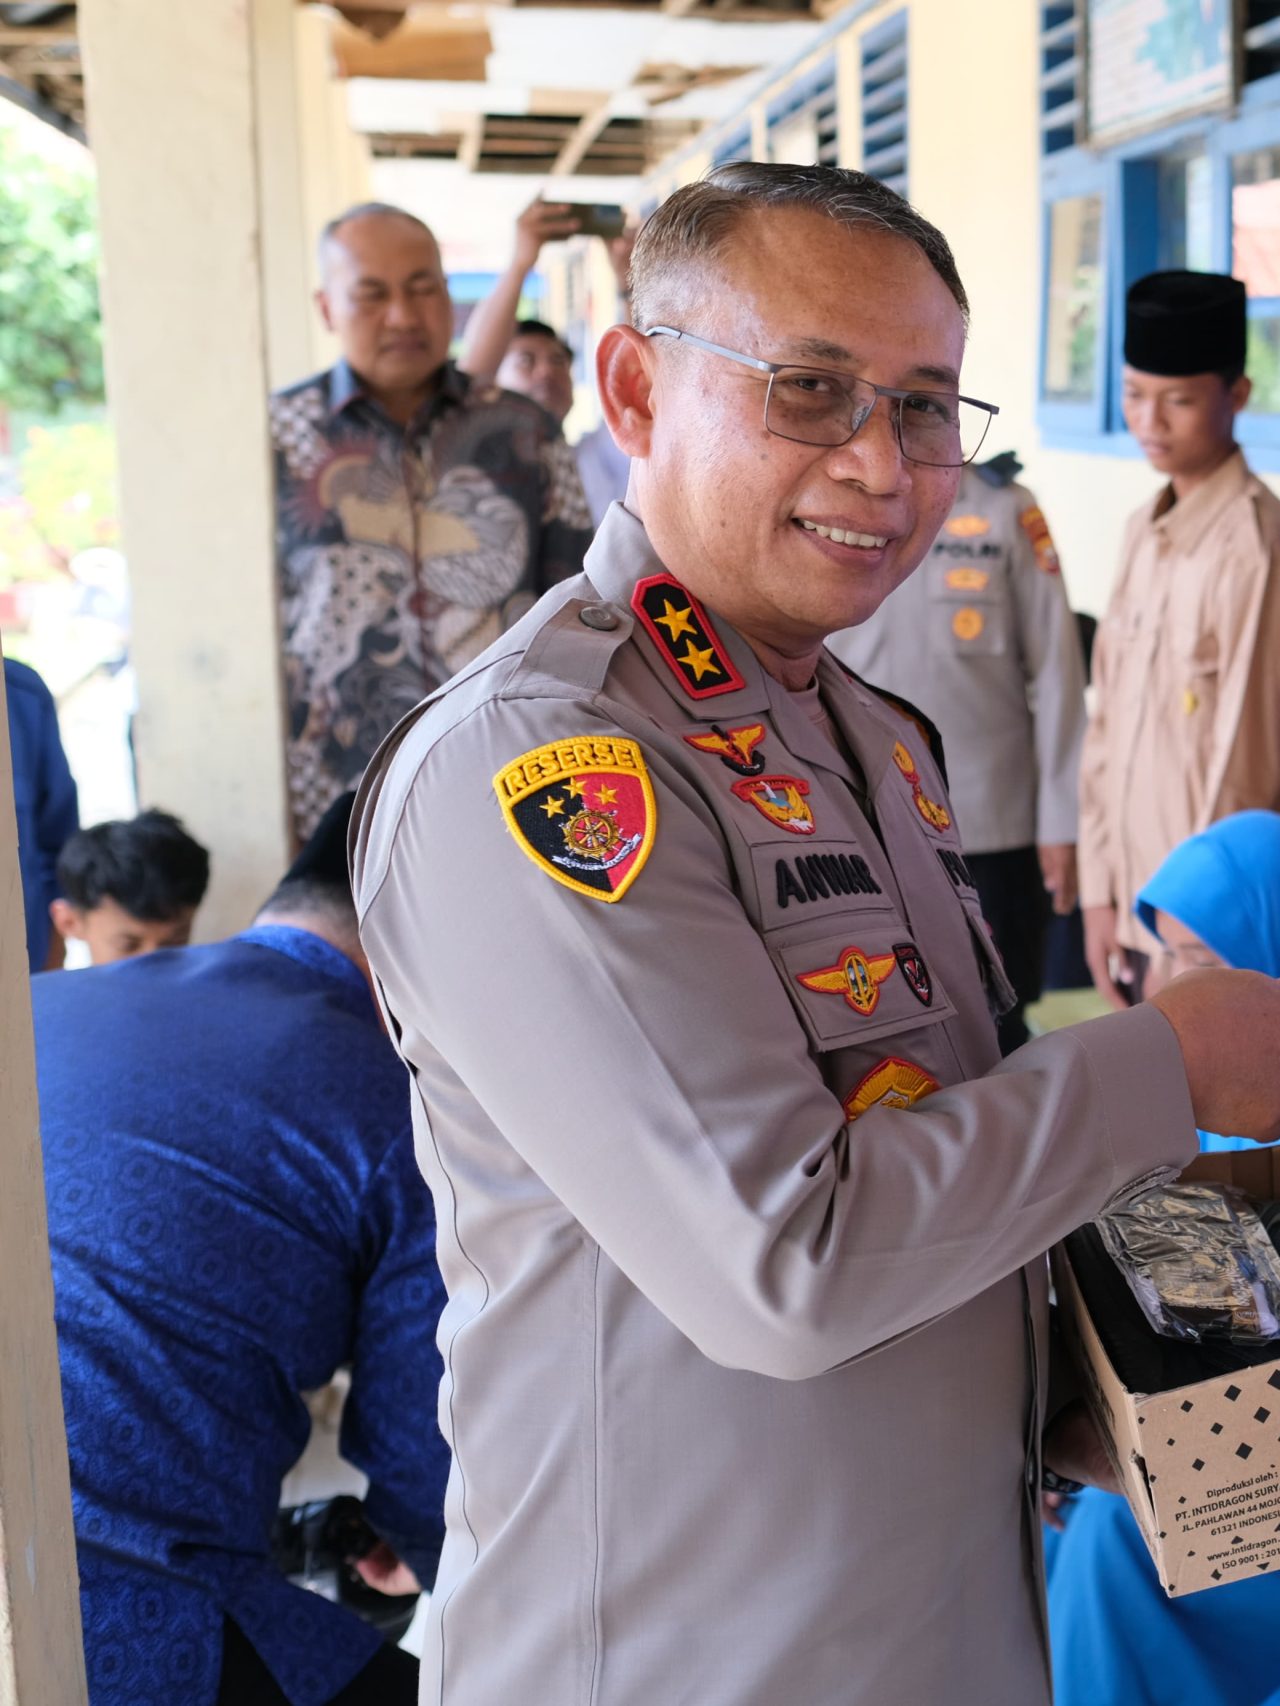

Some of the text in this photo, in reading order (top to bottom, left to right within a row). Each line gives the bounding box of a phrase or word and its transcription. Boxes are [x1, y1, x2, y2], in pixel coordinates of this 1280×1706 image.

[504, 743, 634, 796] RESERSE
[775, 853, 882, 909] ANWAR
[1206, 1477, 1254, 1498] Diproduksi
[1255, 1472, 1274, 1484] oleh
[1175, 1511, 1191, 1522] PT.
[1192, 1492, 1253, 1516] INTIDRAGON
[1195, 1507, 1245, 1528] PAHLAWAN
[1246, 1504, 1258, 1513] 44
[1210, 1522, 1237, 1536] 61321
[1222, 1559, 1237, 1570] ISO
